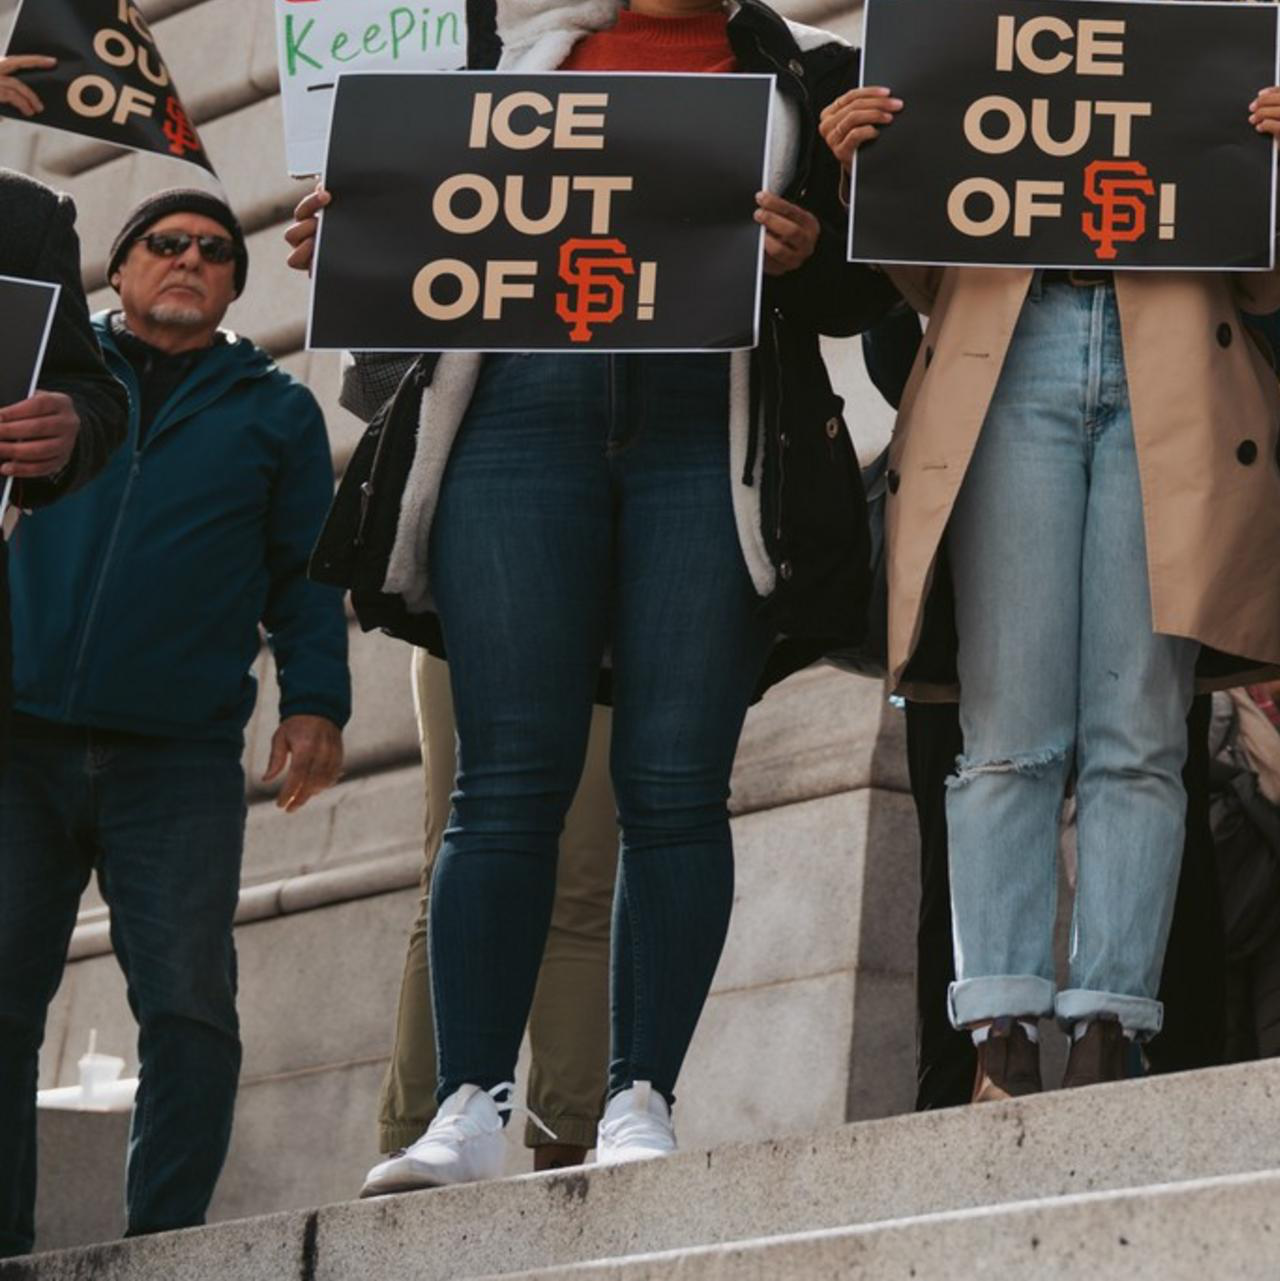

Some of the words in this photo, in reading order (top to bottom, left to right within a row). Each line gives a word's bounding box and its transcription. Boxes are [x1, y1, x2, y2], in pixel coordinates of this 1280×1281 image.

[93, 28, 169, 87] OU
[996, 16, 1125, 76] ICE
[67, 74, 156, 125] OF
[469, 92, 608, 149] ICE
[963, 96, 1152, 157] OUT
[433, 173, 632, 235] OUT
[948, 178, 1064, 237] OF
[412, 258, 537, 320] OF
